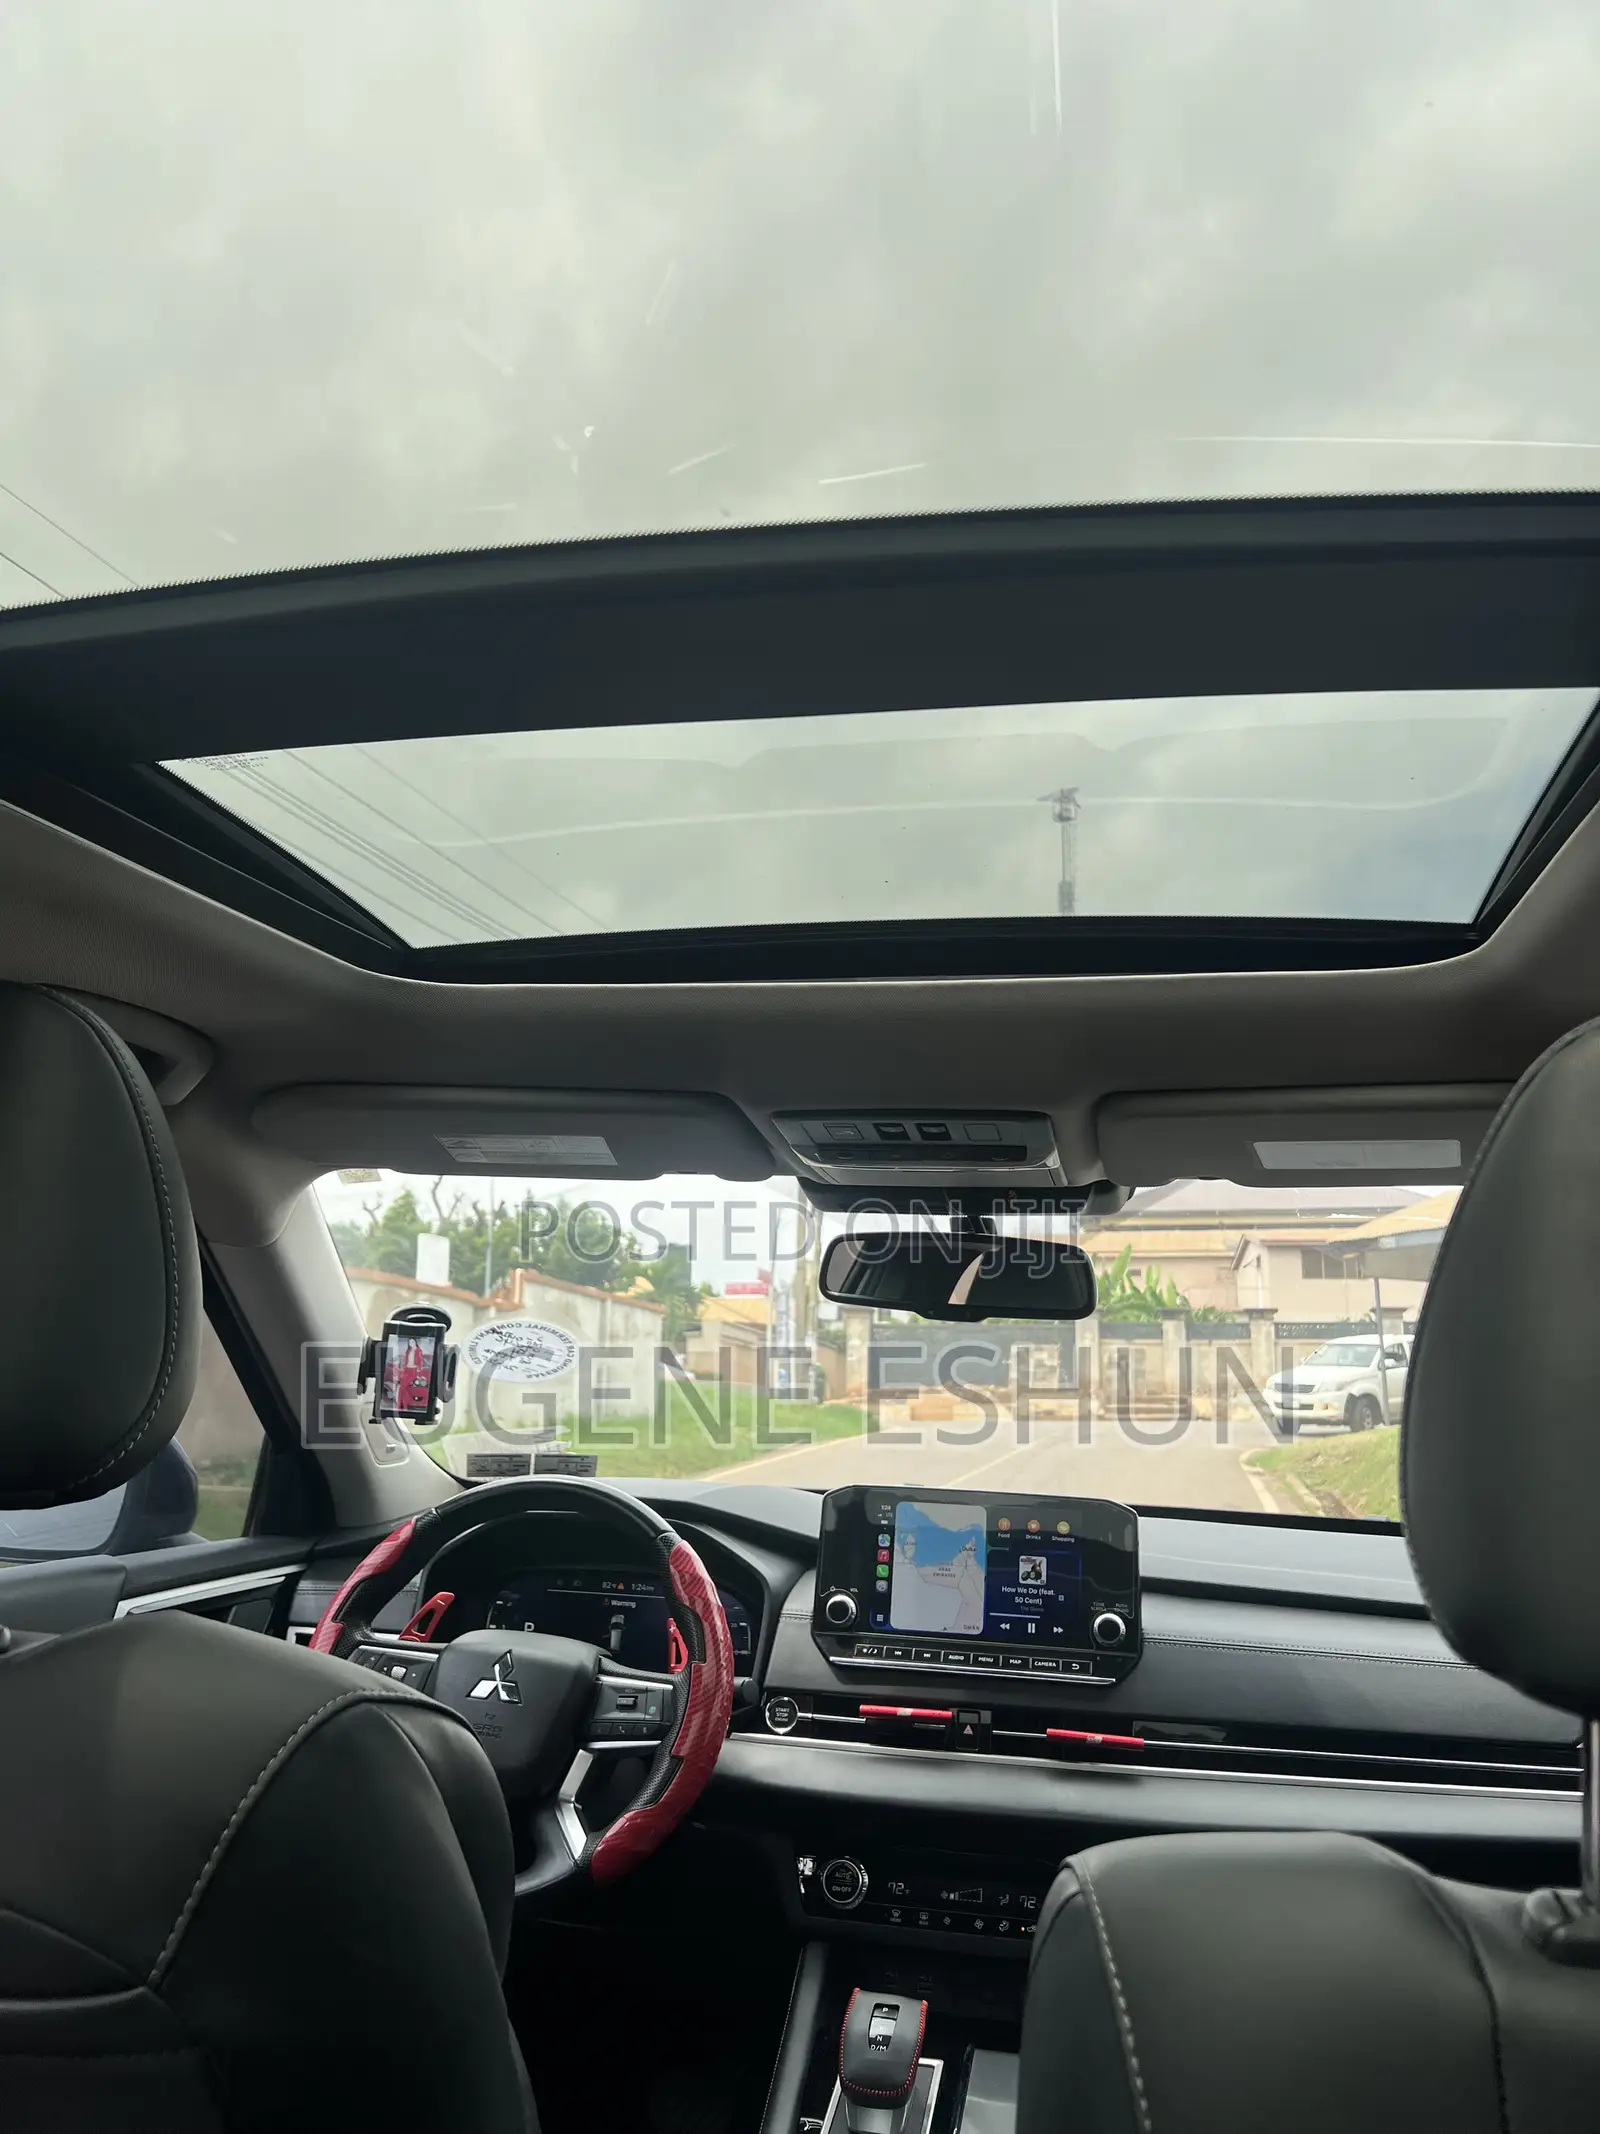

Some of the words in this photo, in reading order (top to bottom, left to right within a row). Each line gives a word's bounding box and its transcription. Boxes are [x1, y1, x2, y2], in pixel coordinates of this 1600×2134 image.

[1039, 1588, 1056, 1596] (feat.
[611, 1600, 636, 1608] Warning
[1024, 1597, 1043, 1605] Cent)
[524, 1622, 535, 1632] P
